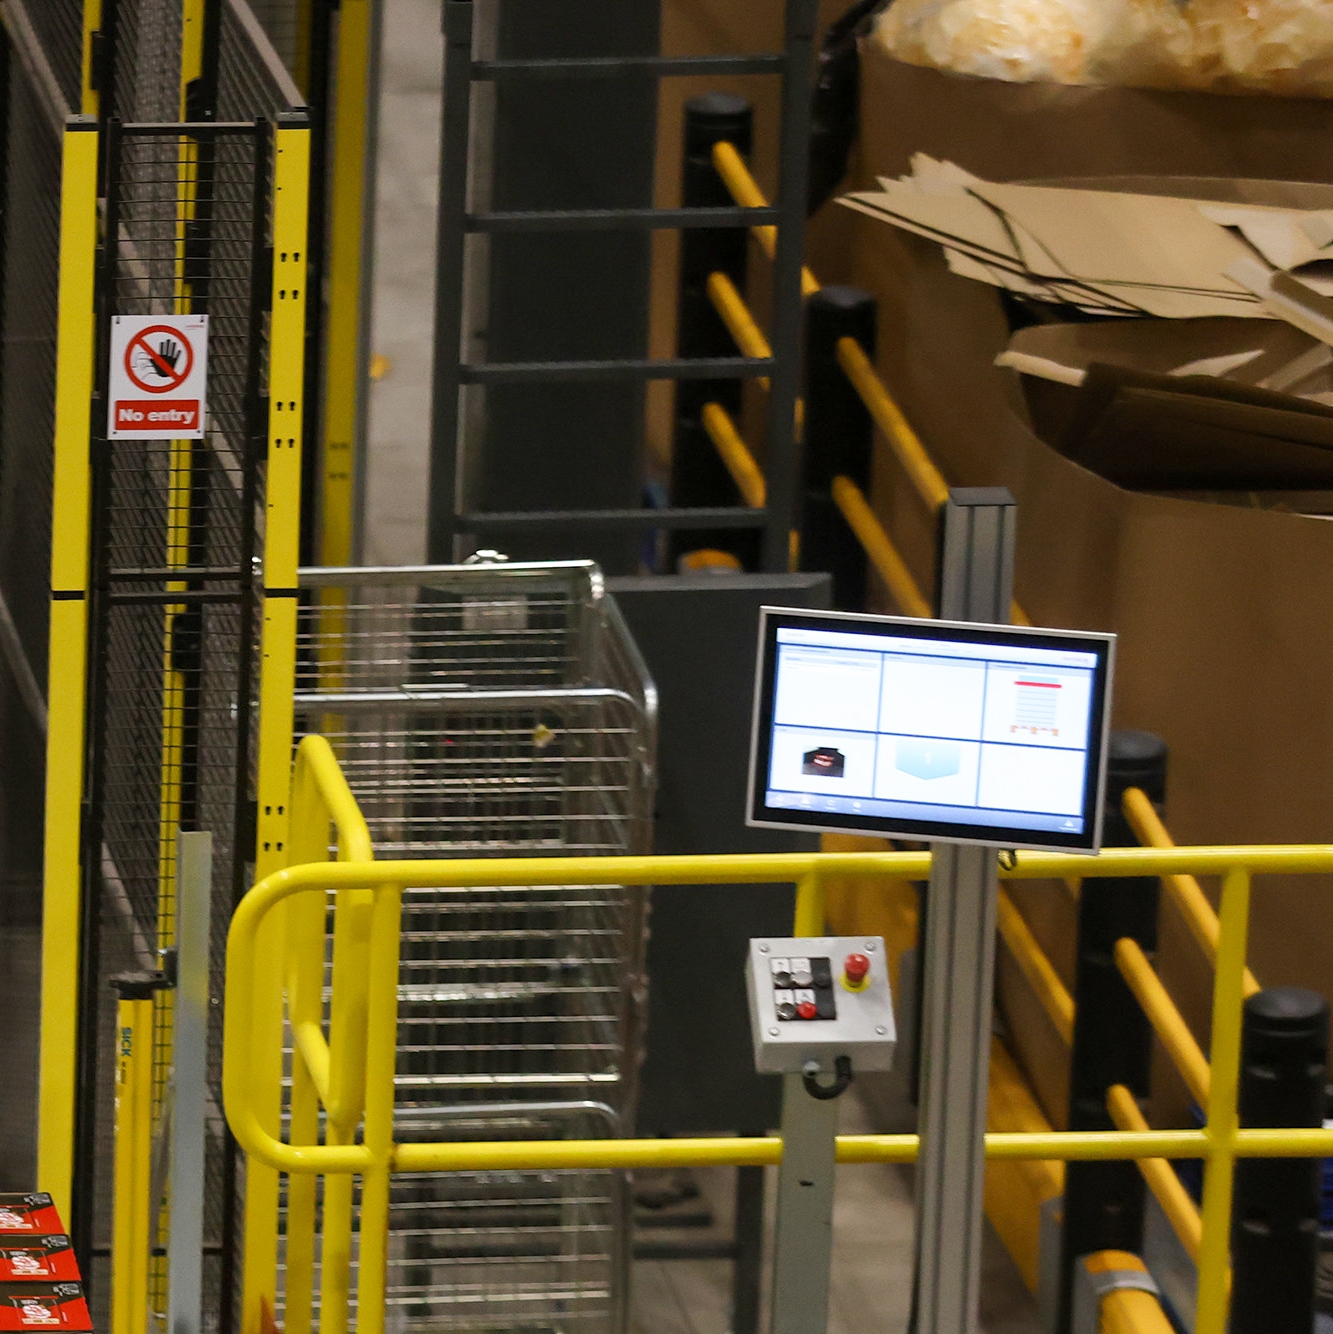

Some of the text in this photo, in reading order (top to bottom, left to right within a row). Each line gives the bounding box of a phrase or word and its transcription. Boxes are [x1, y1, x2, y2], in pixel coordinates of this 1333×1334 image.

[119, 409, 195, 424] No entry
[120, 1027, 132, 1058] SICK
